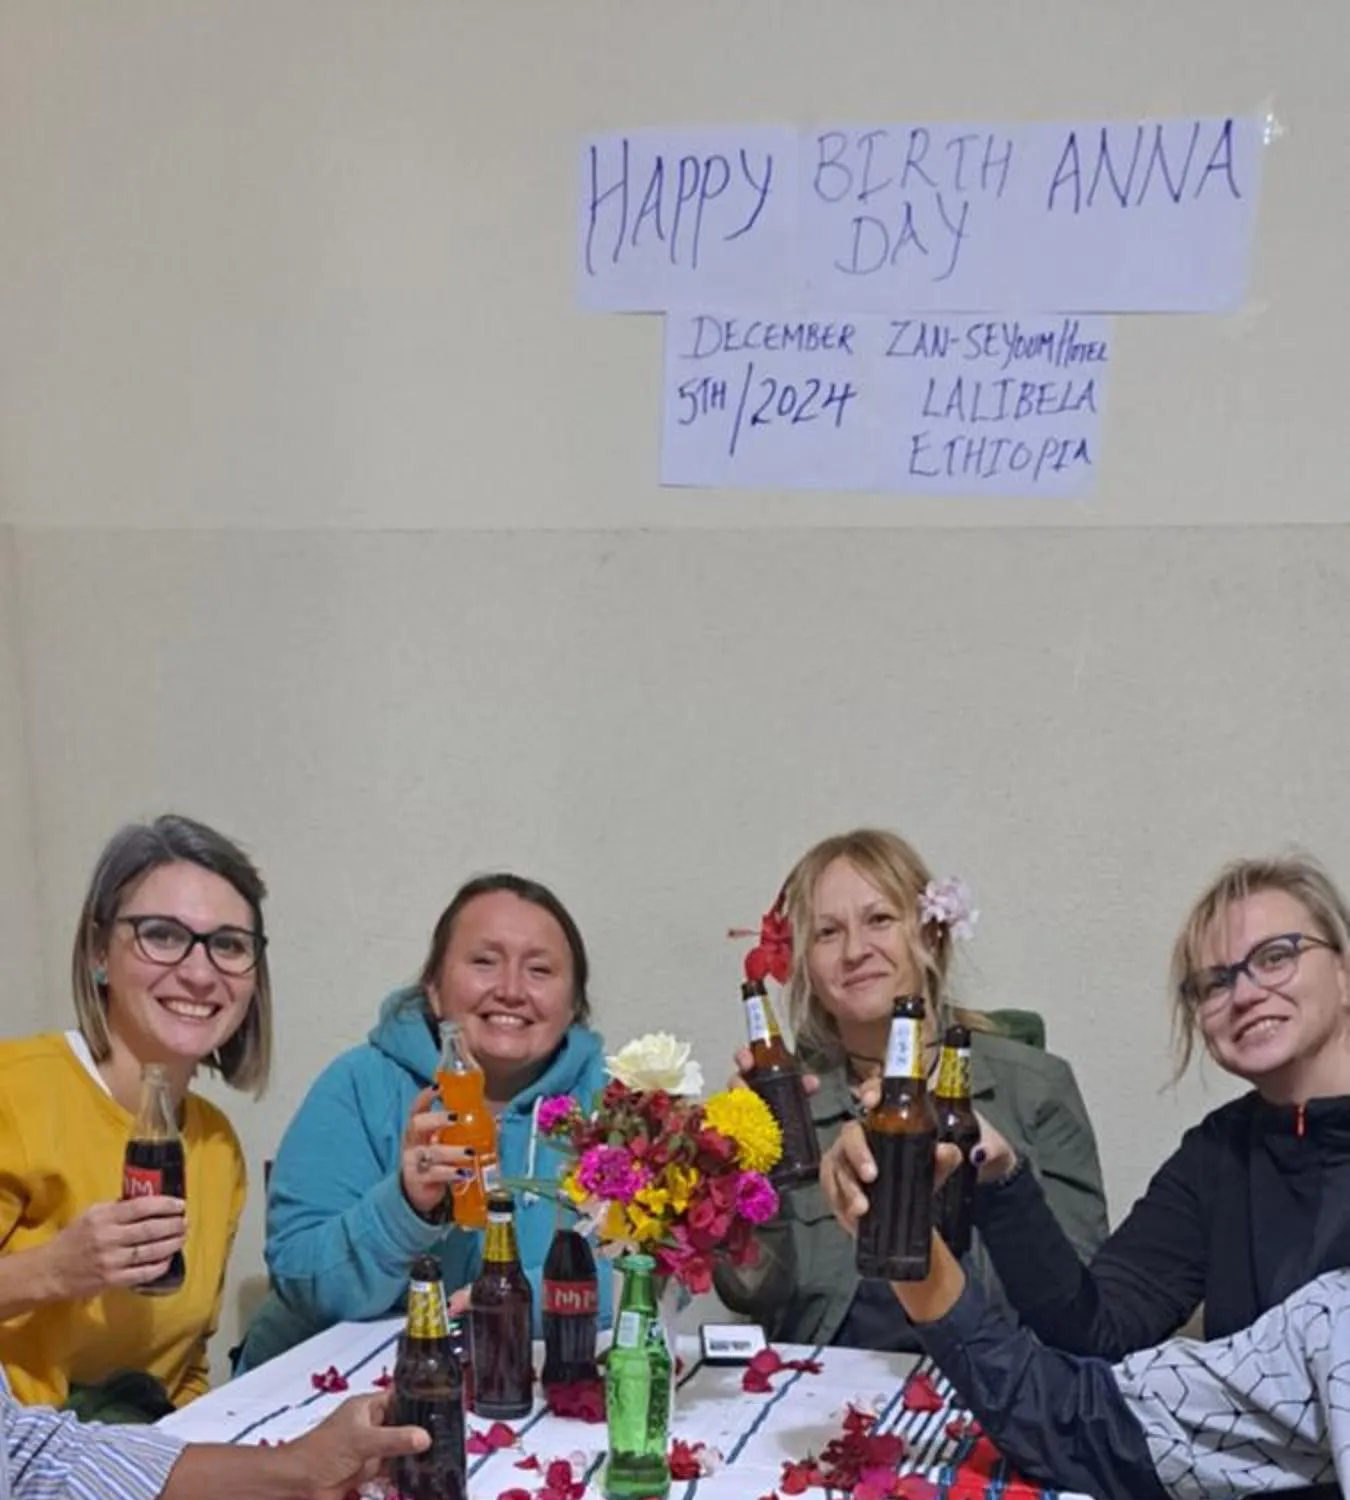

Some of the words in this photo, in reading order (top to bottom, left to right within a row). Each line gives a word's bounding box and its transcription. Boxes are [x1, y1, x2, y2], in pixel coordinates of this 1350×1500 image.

[586, 138, 772, 276] HAPPY
[813, 127, 1013, 204] BIRTH
[1048, 119, 1242, 214] ANNA
[834, 191, 969, 282] DAY
[679, 315, 857, 359] DECEMBER
[921, 376, 1097, 423] LALIBELA
[909, 431, 1092, 481] ETHIOPIA
